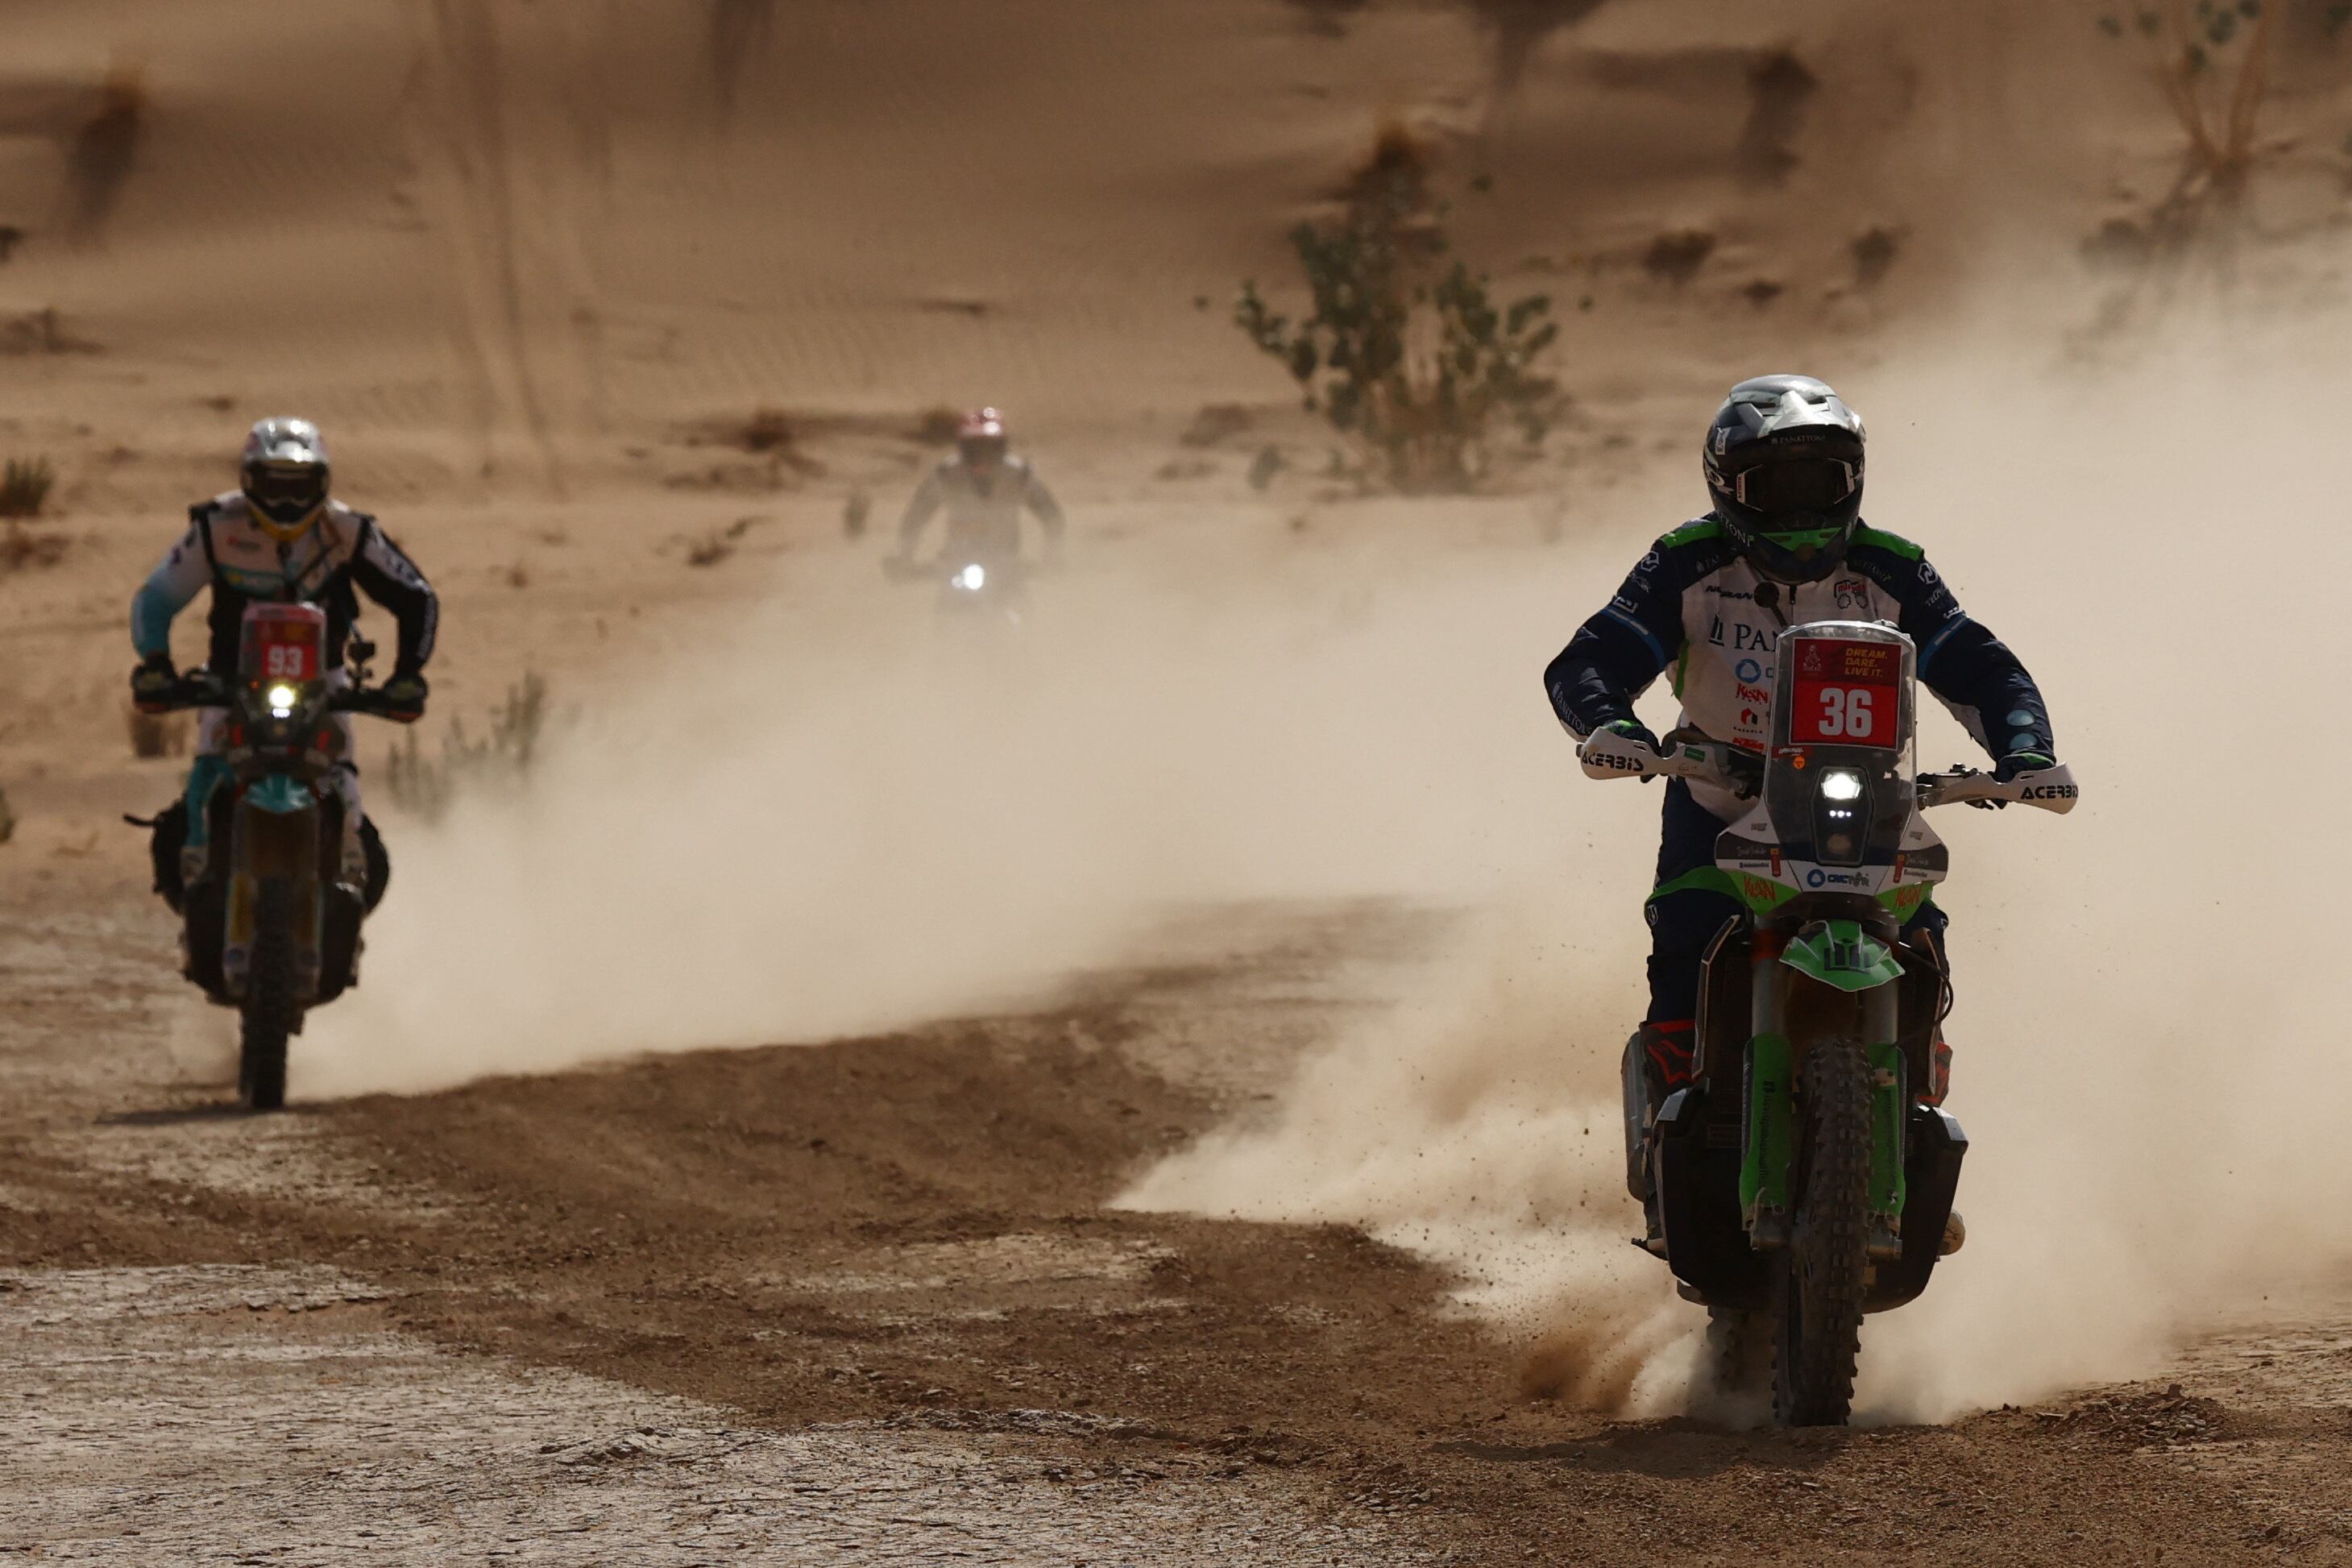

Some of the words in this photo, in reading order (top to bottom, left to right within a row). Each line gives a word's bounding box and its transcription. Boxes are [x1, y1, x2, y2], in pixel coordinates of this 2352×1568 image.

[1846, 648, 1888, 659] DREAM.
[267, 645, 304, 676] 93
[1845, 657, 1878, 667] DARE.
[1844, 667, 1869, 676] LIVE
[1871, 669, 1883, 678] IT.
[1819, 687, 1873, 737] 36
